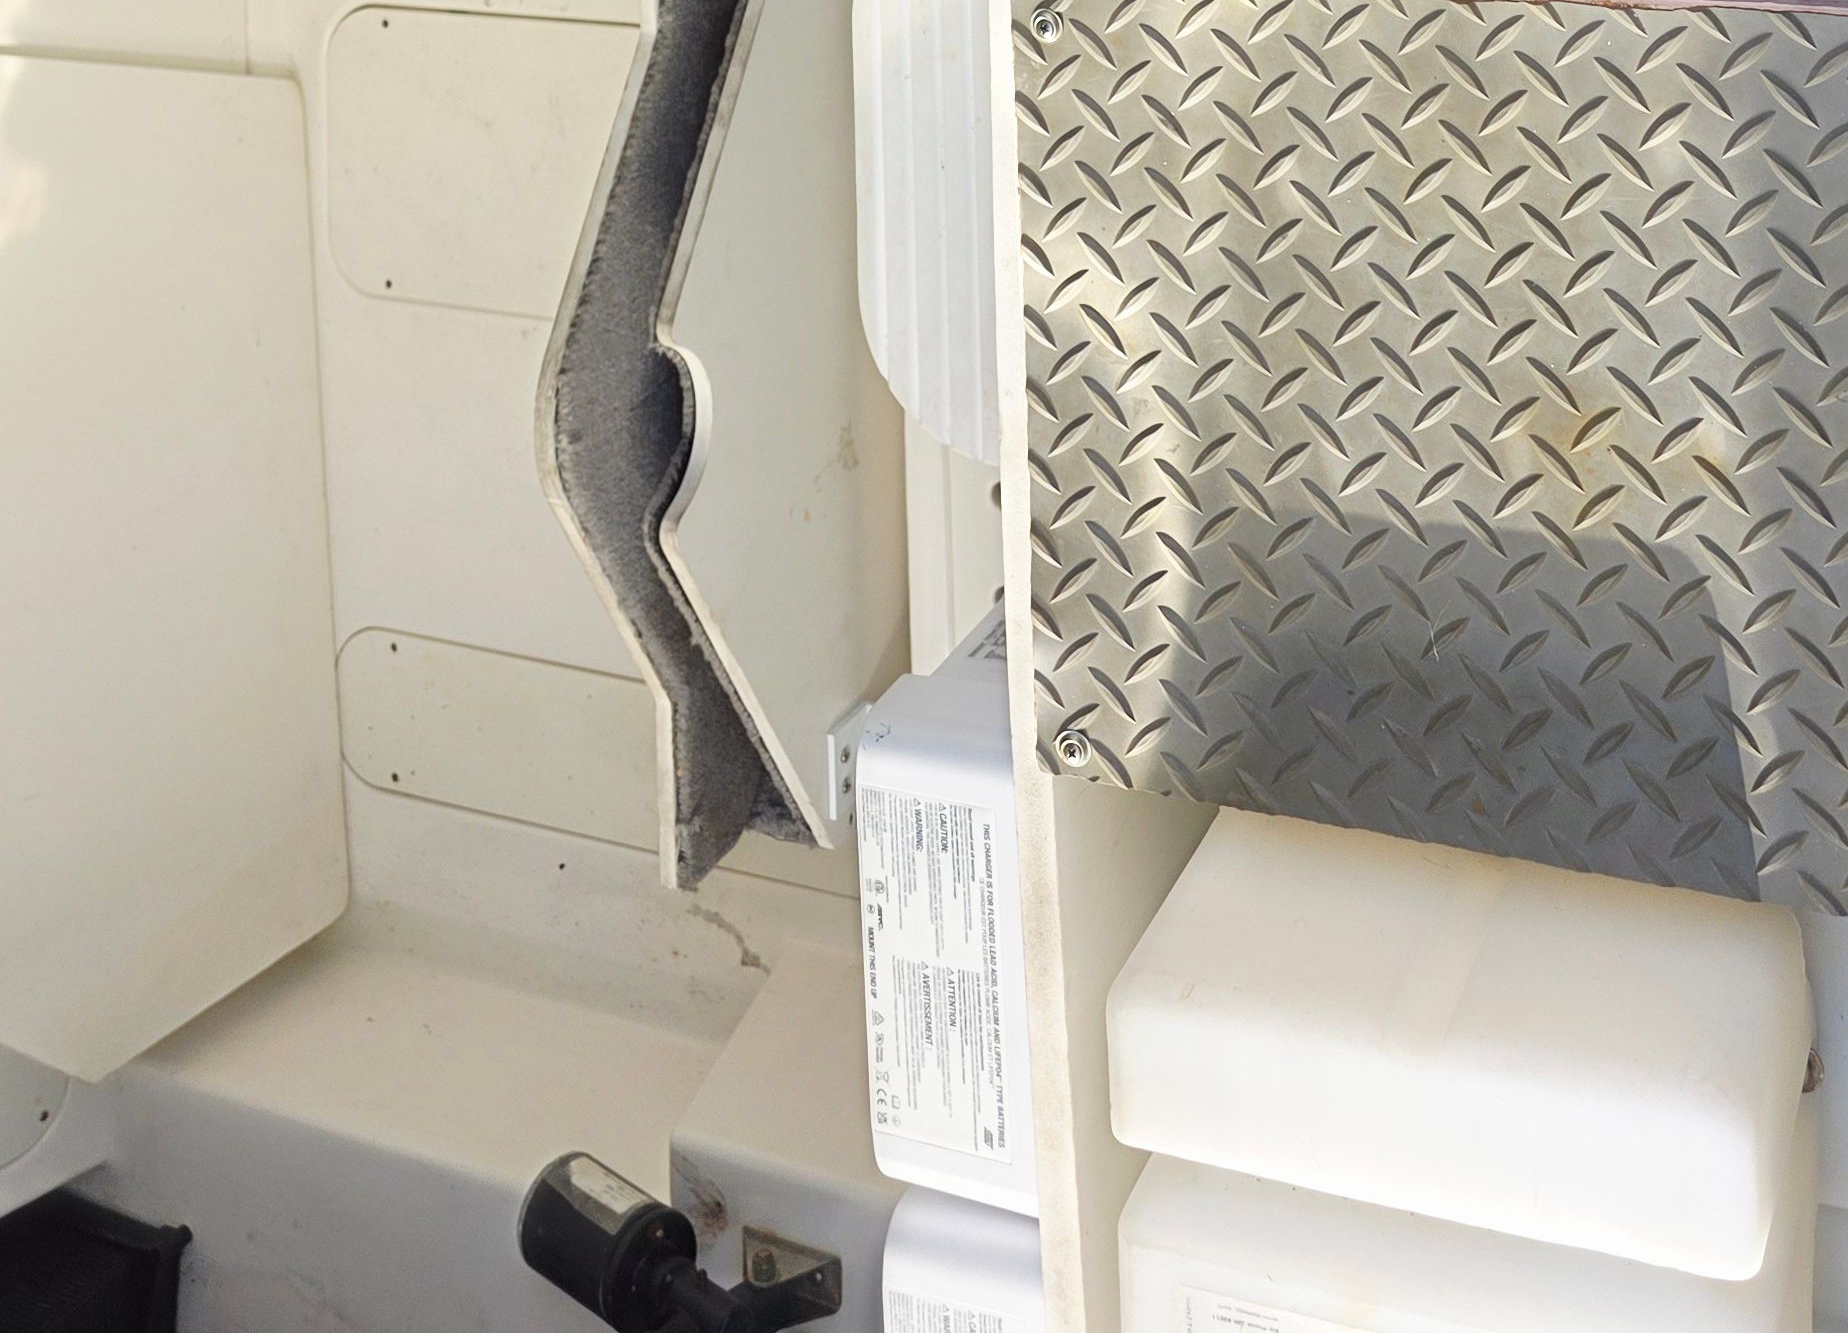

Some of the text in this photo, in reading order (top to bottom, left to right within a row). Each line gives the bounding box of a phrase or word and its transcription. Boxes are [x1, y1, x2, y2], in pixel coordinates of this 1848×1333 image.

[913, 808, 923, 852] WARNING:
[938, 812, 948, 854] CAUTION:
[982, 823, 990, 840] THIS
[983, 842, 992, 878] CHARGER
[985, 880, 992, 889] IS
[986, 907, 995, 943] FLOODED
[866, 926, 877, 999] MOUNT THIS END UP
[988, 945, 996, 966] LEAD
[921, 972, 933, 1046] AVERTISSEMENT
[946, 978, 957, 1027] ATTENTION
[990, 989, 999, 1026] CALCIUM
[992, 1026, 1000, 1044] AND
[875, 1087, 886, 1106] CE
[995, 1084, 1003, 1105] TYPE
[996, 1106, 1005, 1148] BATTERIES
